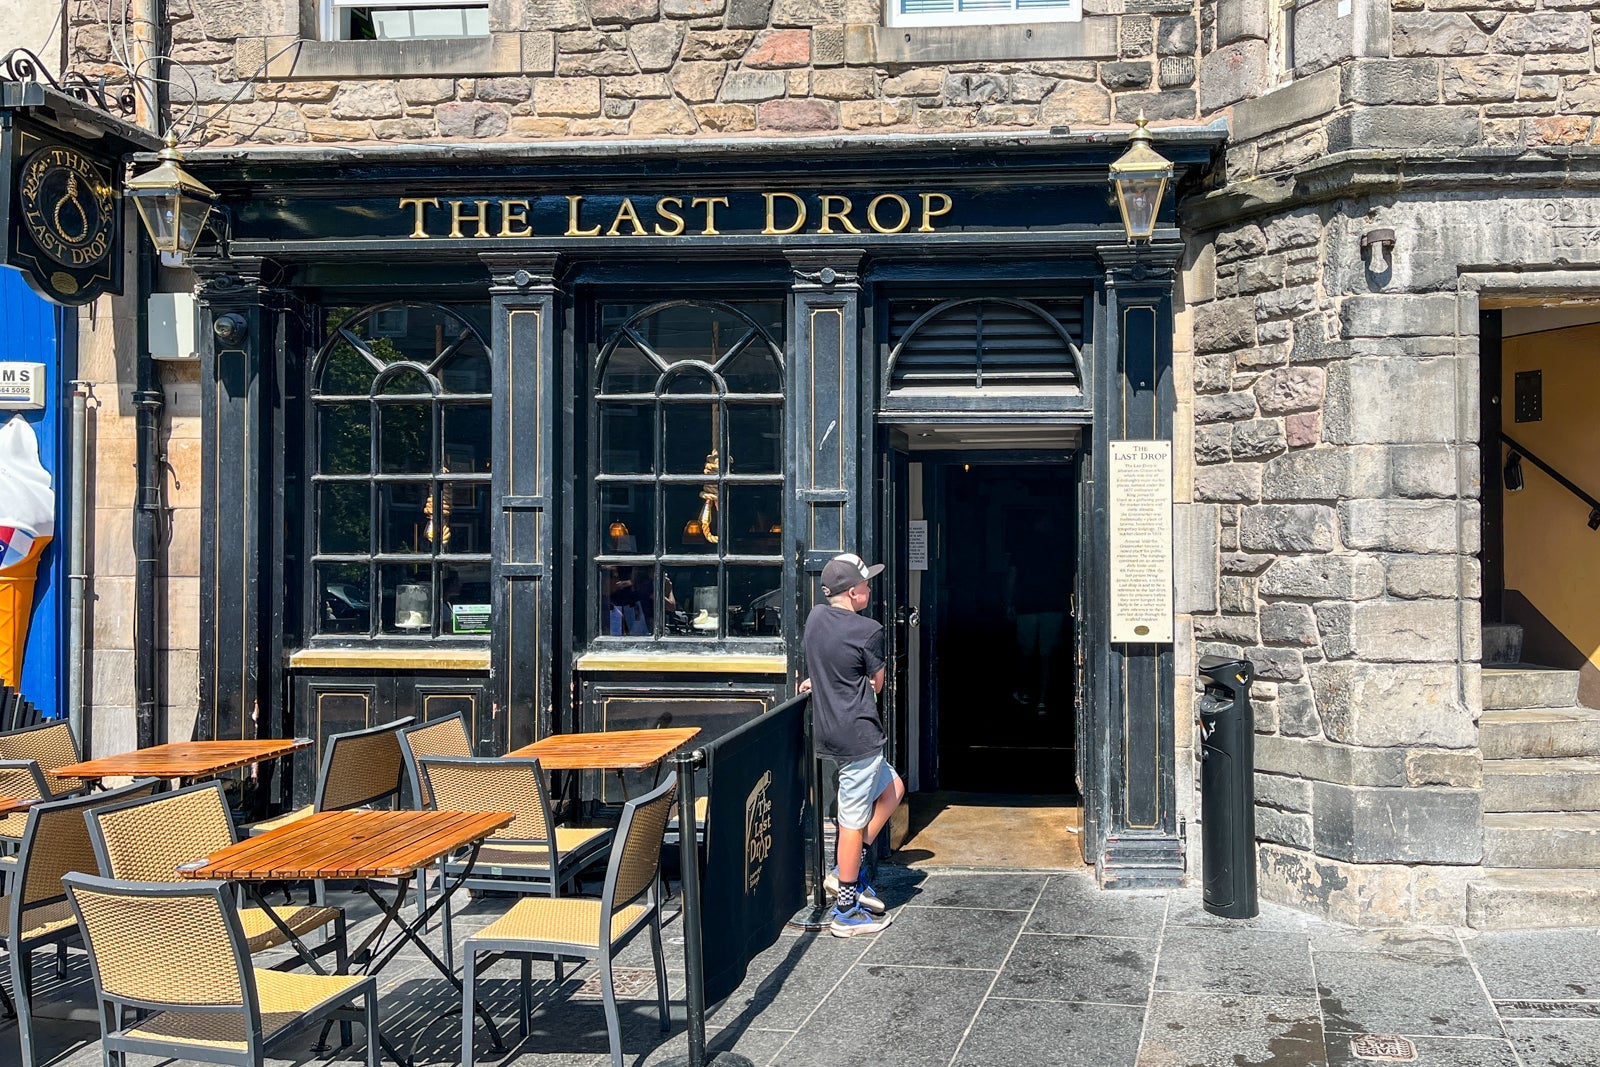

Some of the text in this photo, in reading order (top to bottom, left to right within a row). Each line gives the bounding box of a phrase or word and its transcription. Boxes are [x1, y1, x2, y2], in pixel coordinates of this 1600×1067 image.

[51, 150, 90, 178] THE
[399, 192, 954, 238] THE LAST DROP
[26, 210, 108, 264] LAST DROP
[758, 798, 772, 817] The
[754, 816, 772, 838] Last
[750, 834, 772, 863] Drop
